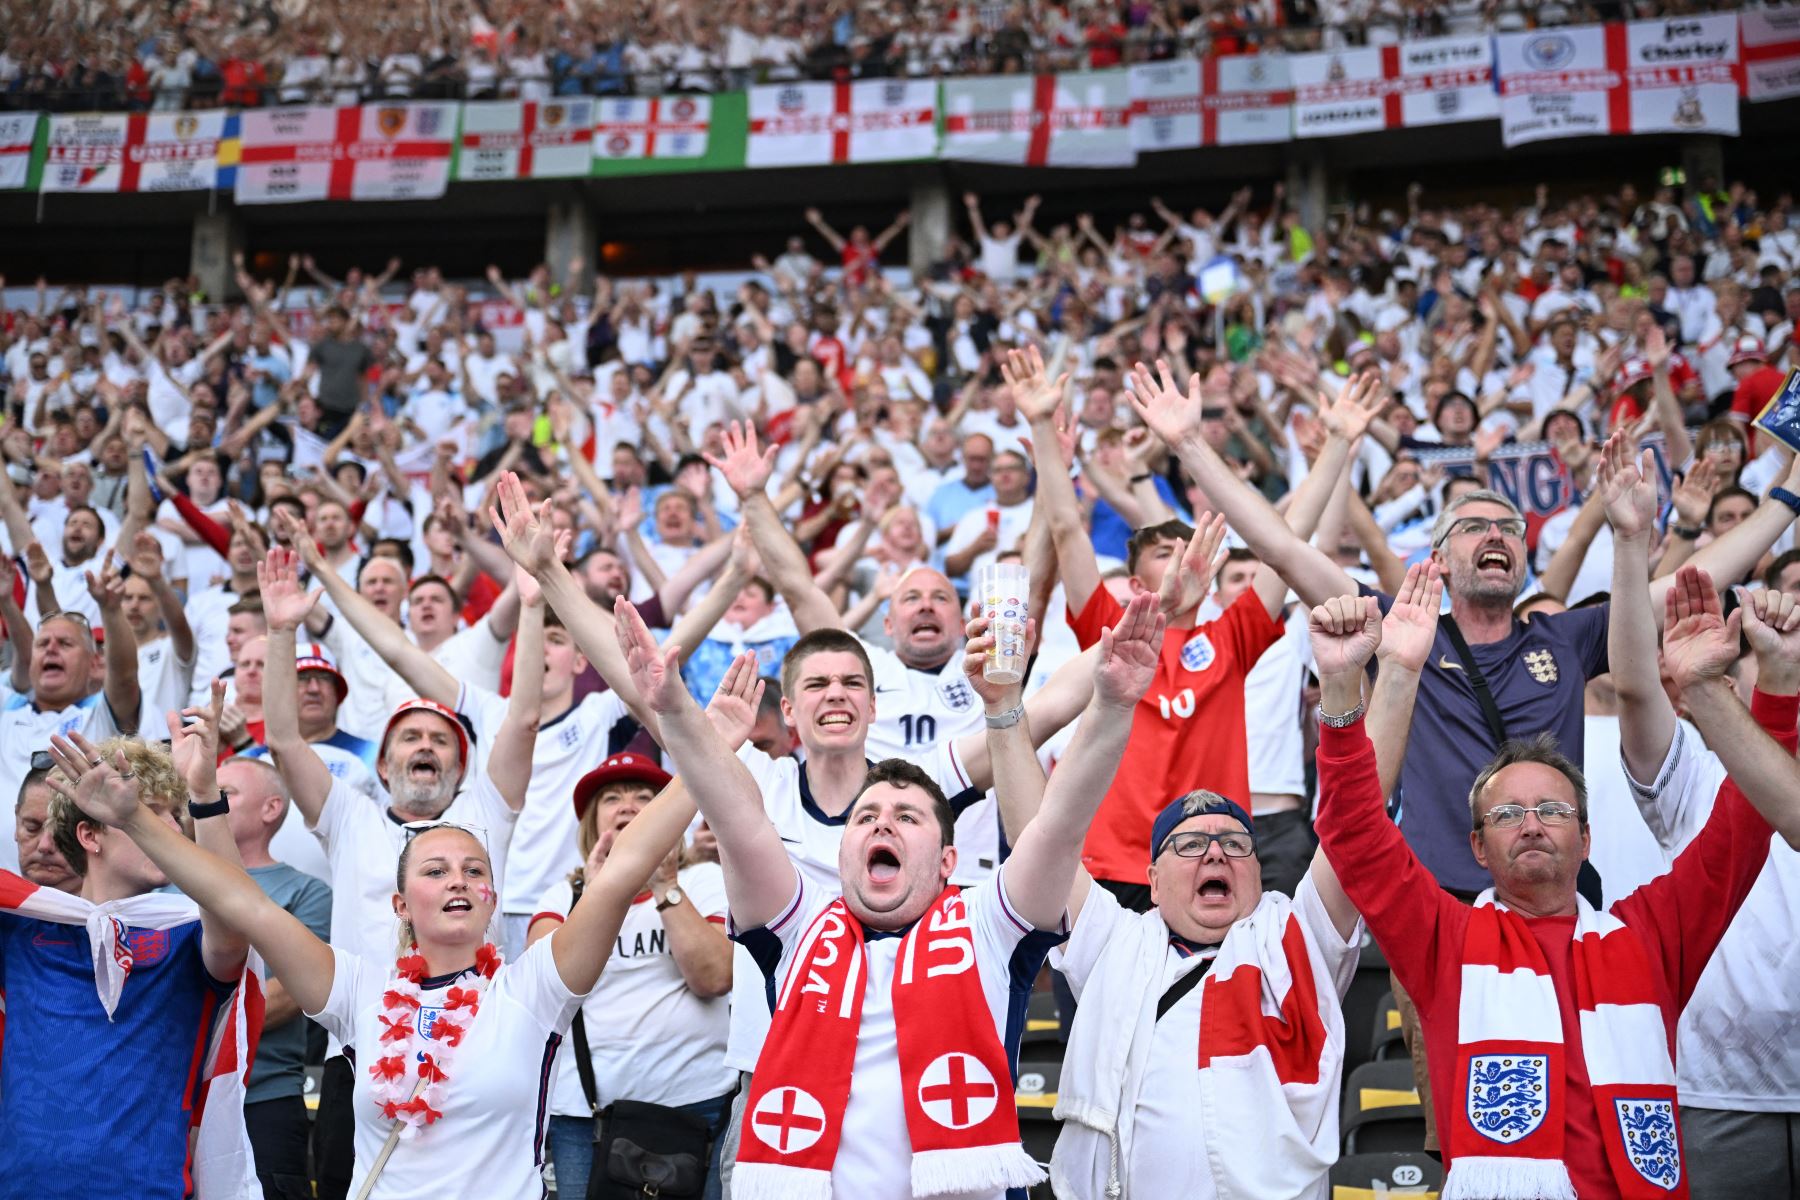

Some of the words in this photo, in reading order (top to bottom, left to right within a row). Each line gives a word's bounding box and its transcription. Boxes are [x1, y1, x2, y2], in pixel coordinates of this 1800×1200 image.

[50, 145, 121, 164] LEEDS
[129, 140, 216, 163] UNITED
[1158, 688, 1196, 719] 10
[899, 714, 936, 746] 10
[616, 928, 672, 958] LAN
[1400, 1170, 1416, 1181] 12
